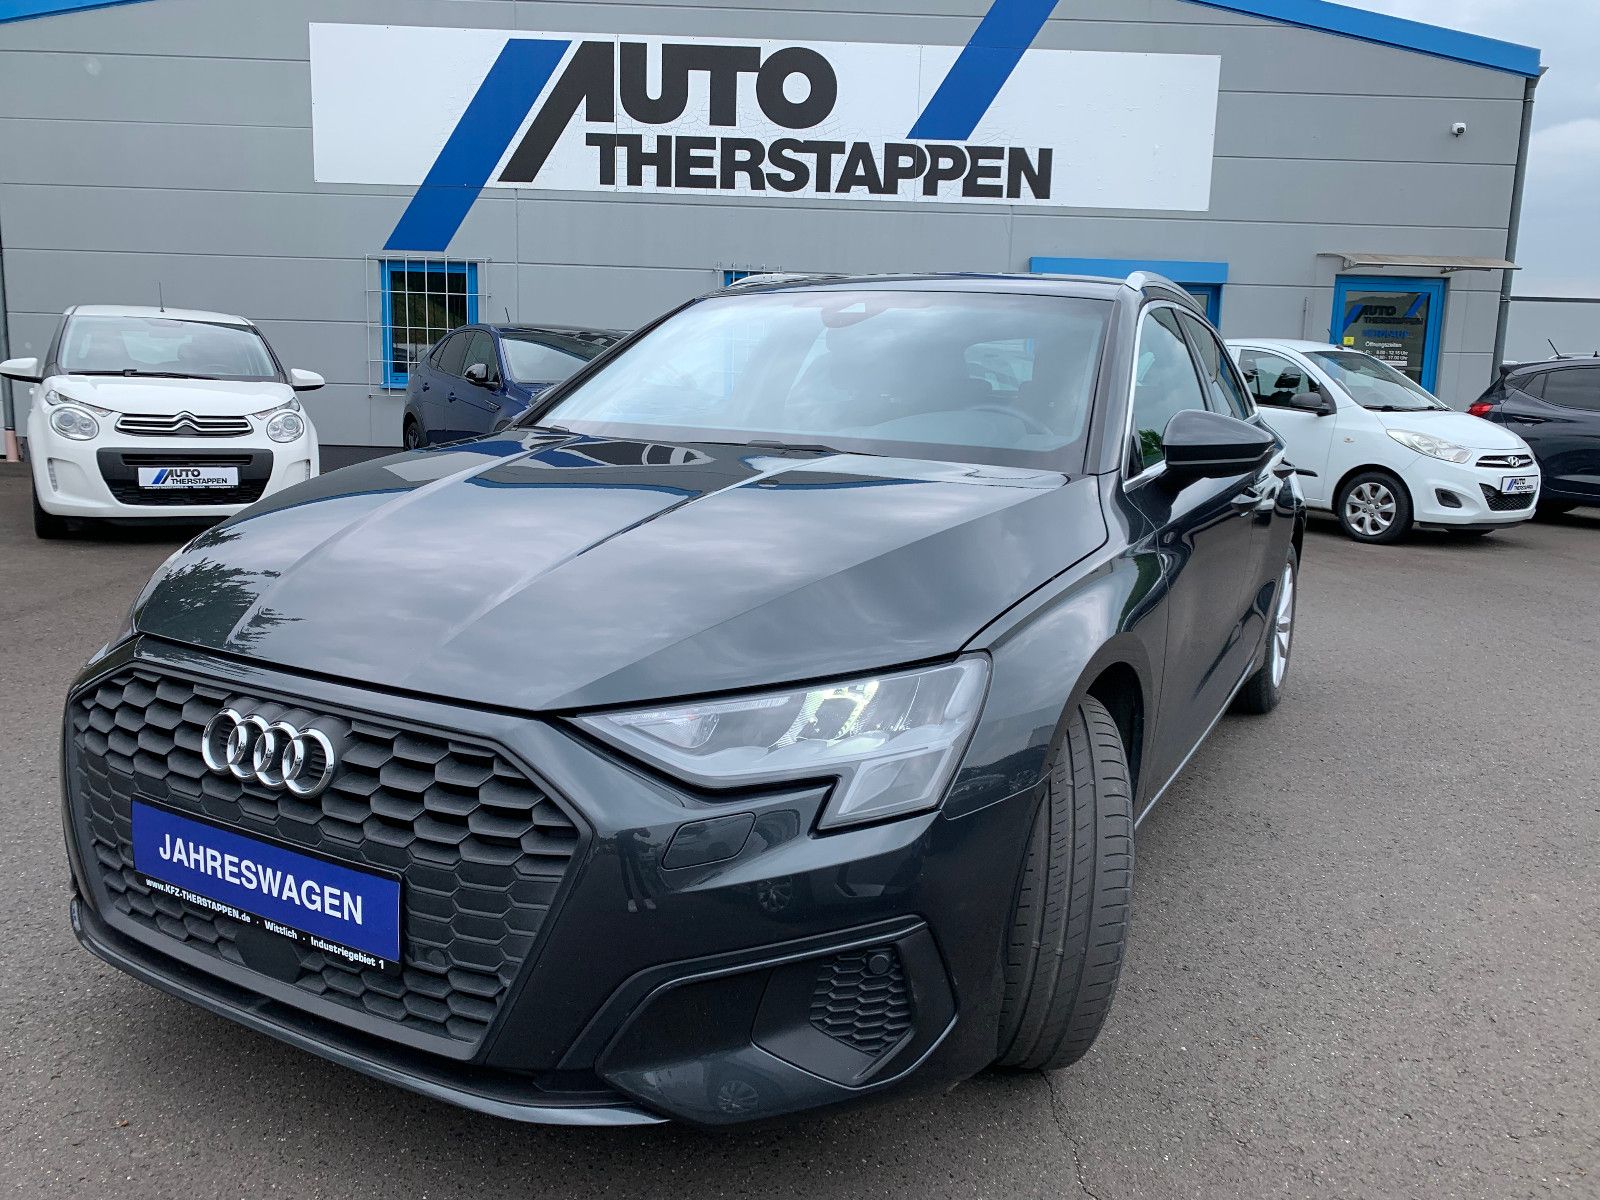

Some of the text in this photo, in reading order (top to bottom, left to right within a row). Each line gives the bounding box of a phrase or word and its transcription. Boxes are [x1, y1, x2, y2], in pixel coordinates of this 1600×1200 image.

[498, 41, 837, 182] AUTO
[585, 132, 1052, 199] THERSTAPPEN
[1352, 305, 1397, 323] AUTO
[161, 469, 200, 484] AUTO
[159, 833, 362, 925] JAHRESWAGEN
[145, 878, 385, 970] www.KFZ-THERSTAPPEN.de Wittlich Industriegebiet 1
